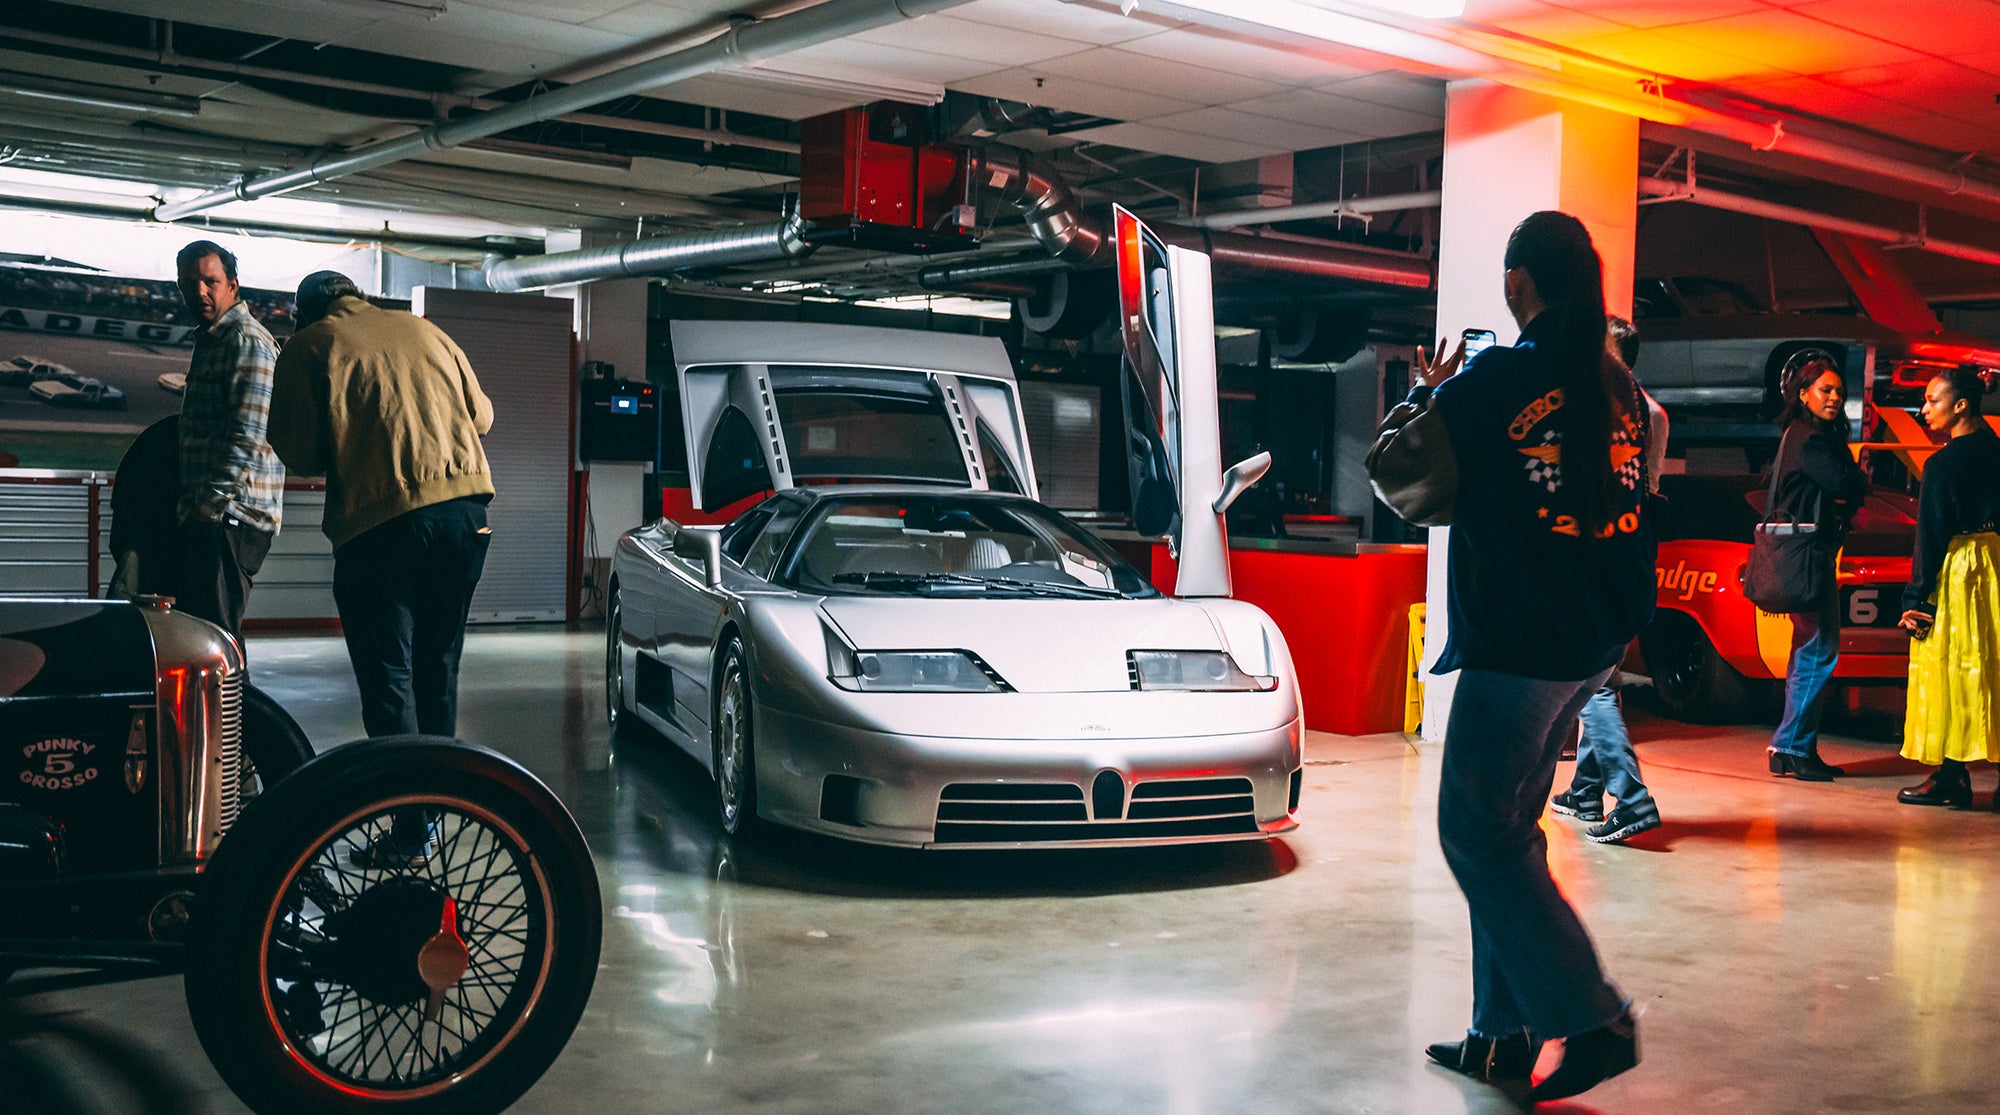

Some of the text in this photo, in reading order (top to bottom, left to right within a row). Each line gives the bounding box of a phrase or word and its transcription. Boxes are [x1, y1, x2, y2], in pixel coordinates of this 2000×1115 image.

[1849, 589, 1879, 624] 6
[23, 738, 96, 758] PUNKY
[44, 753, 75, 774] 5
[20, 767, 98, 790] GROSSO
